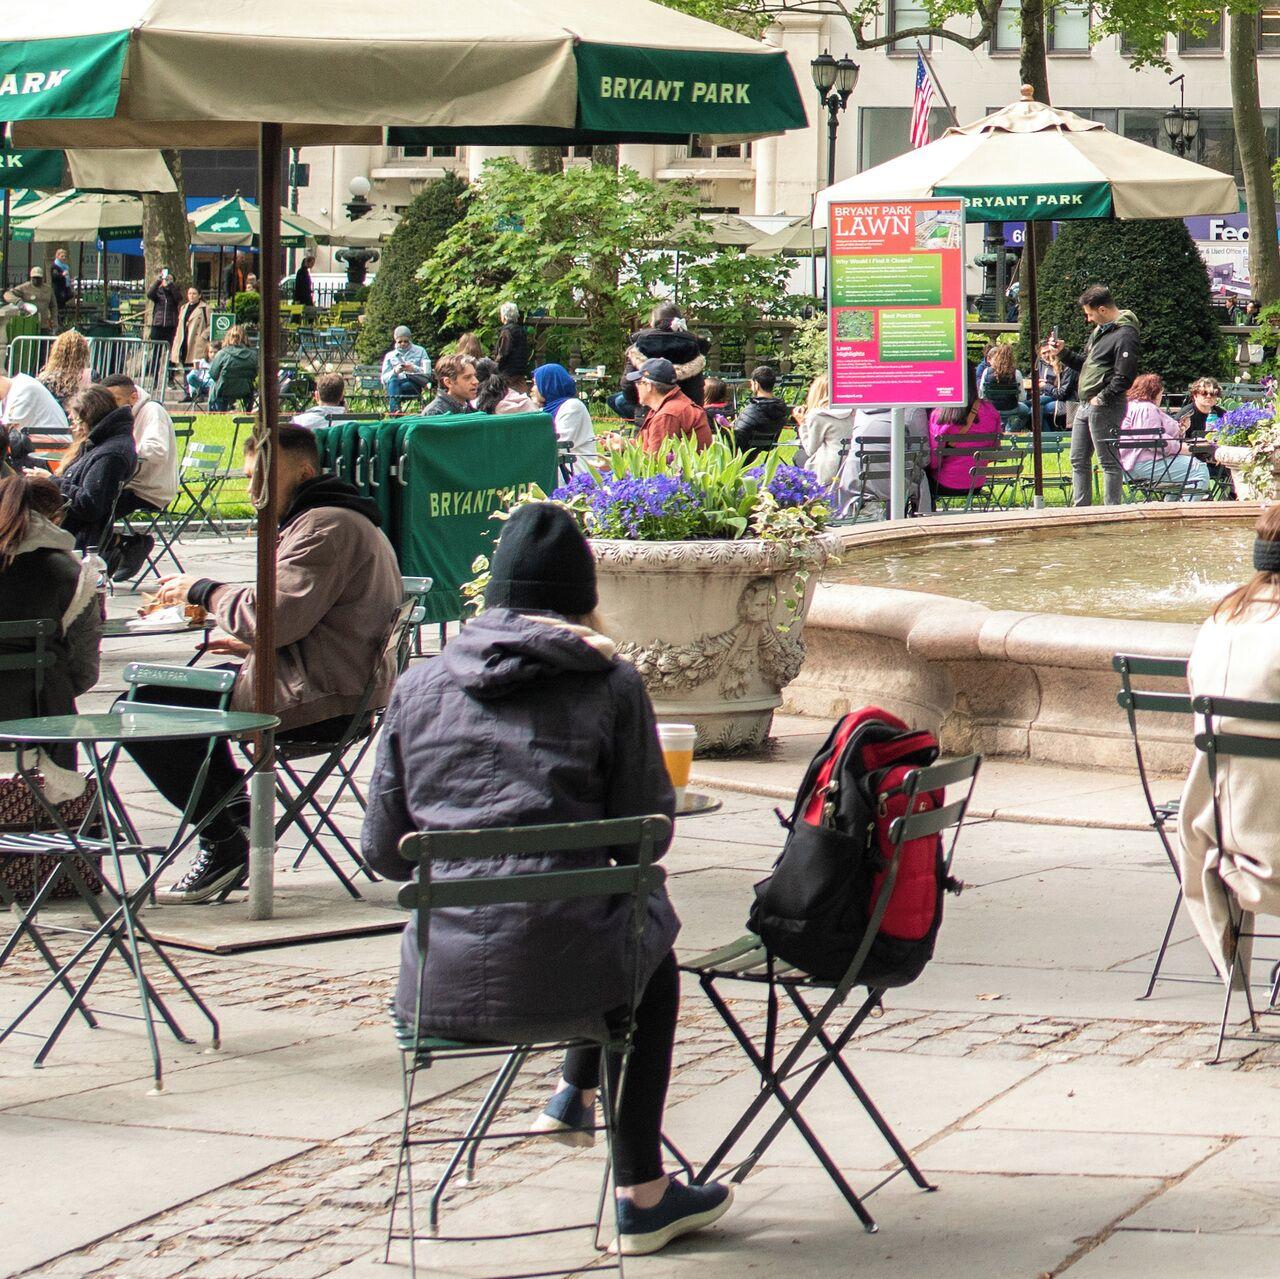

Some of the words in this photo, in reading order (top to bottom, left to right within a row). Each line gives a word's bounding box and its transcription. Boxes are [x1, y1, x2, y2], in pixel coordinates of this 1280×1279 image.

[0, 69, 71, 96] ARK
[601, 76, 685, 102] BRYANT
[691, 82, 751, 104] PARK
[1036, 194, 1083, 205] PARK
[835, 206, 879, 216] BRYANT
[882, 205, 912, 215] PARK
[835, 216, 911, 236] LAWN
[430, 488, 496, 517] BRYANT
[137, 668, 167, 680] BRYANT
[167, 671, 188, 682] PARK
